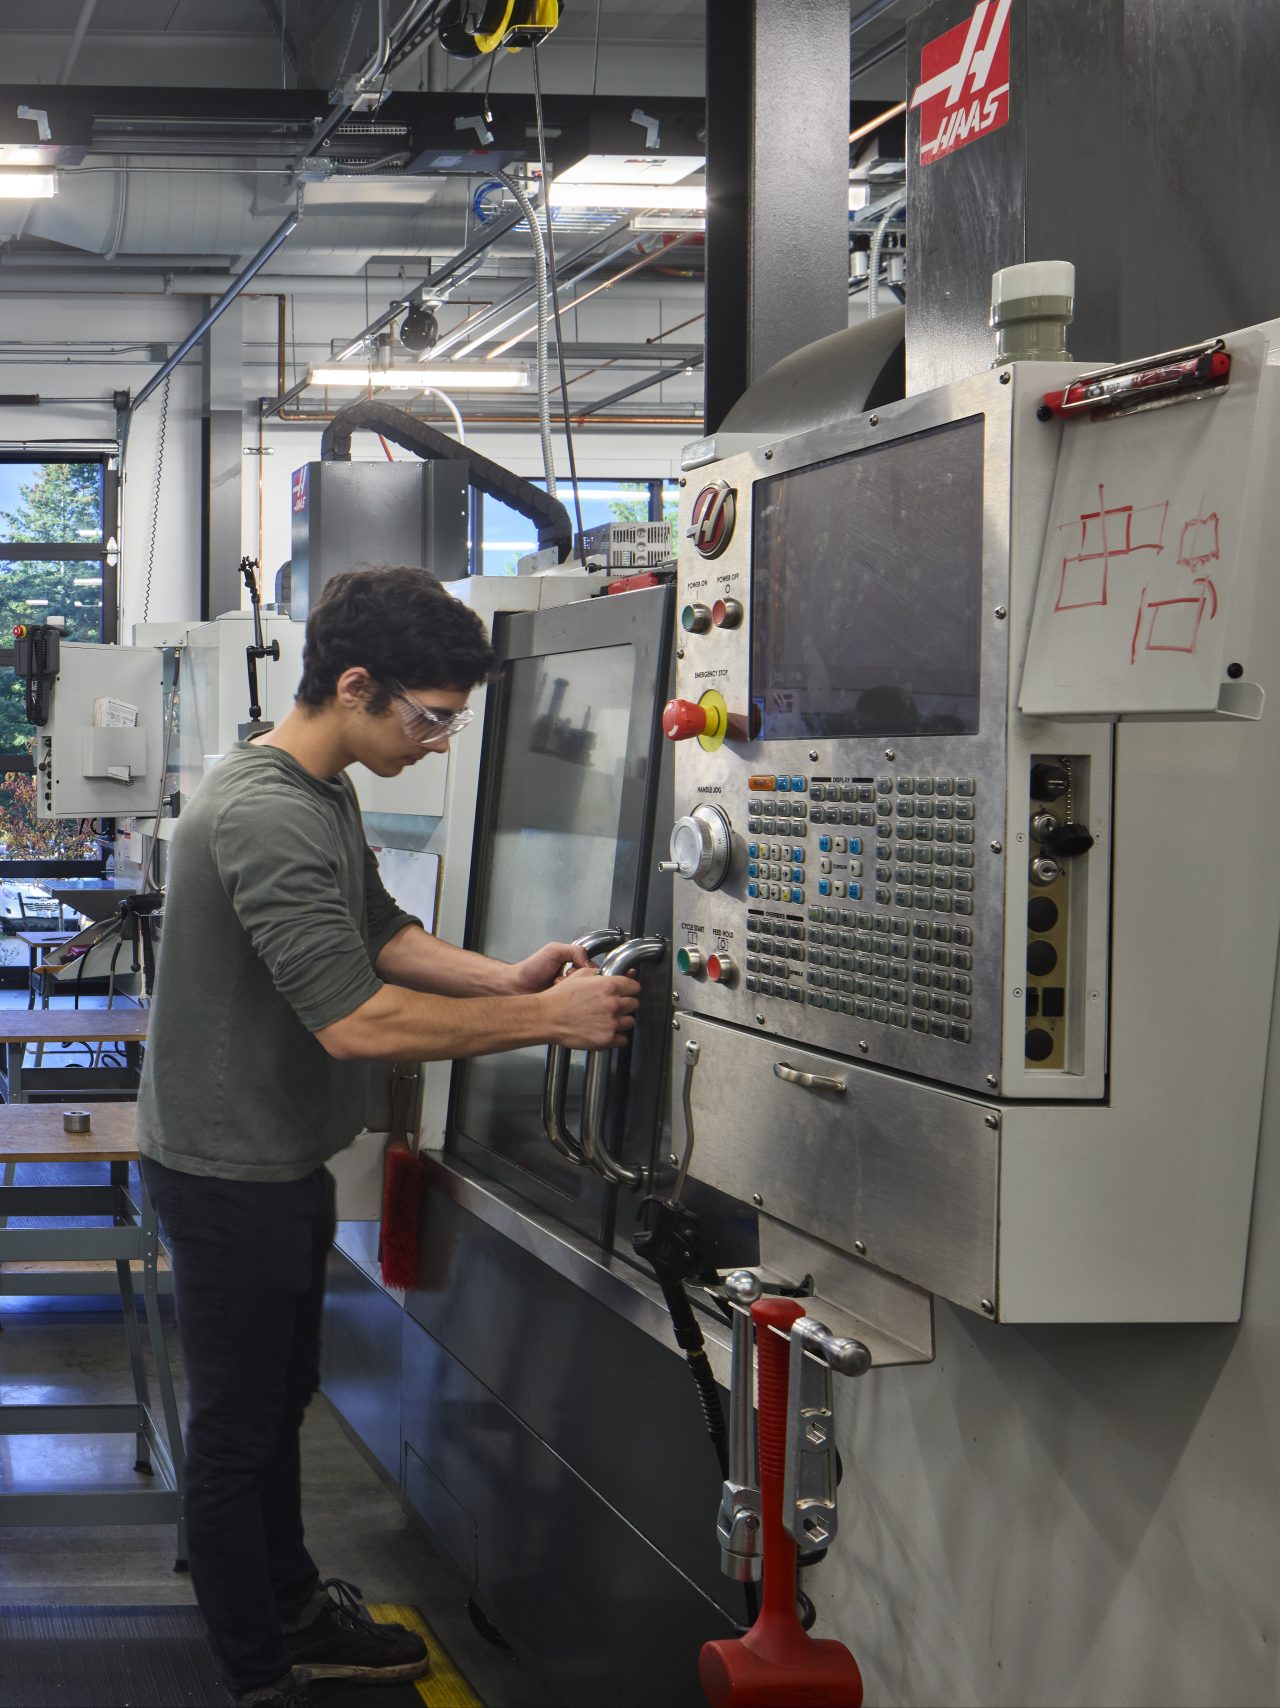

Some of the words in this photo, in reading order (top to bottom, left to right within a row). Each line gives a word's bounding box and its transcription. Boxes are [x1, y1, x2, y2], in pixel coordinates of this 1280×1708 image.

[923, 92, 1004, 155] HAAS
[717, 574, 730, 583] POWER
[687, 581, 700, 589] POWER
[694, 670, 717, 679] EMERGENCY
[681, 922, 693, 931] CYCLE
[694, 924, 705, 933] START
[712, 928, 721, 936] FEED
[722, 930, 734, 939] HOLD
